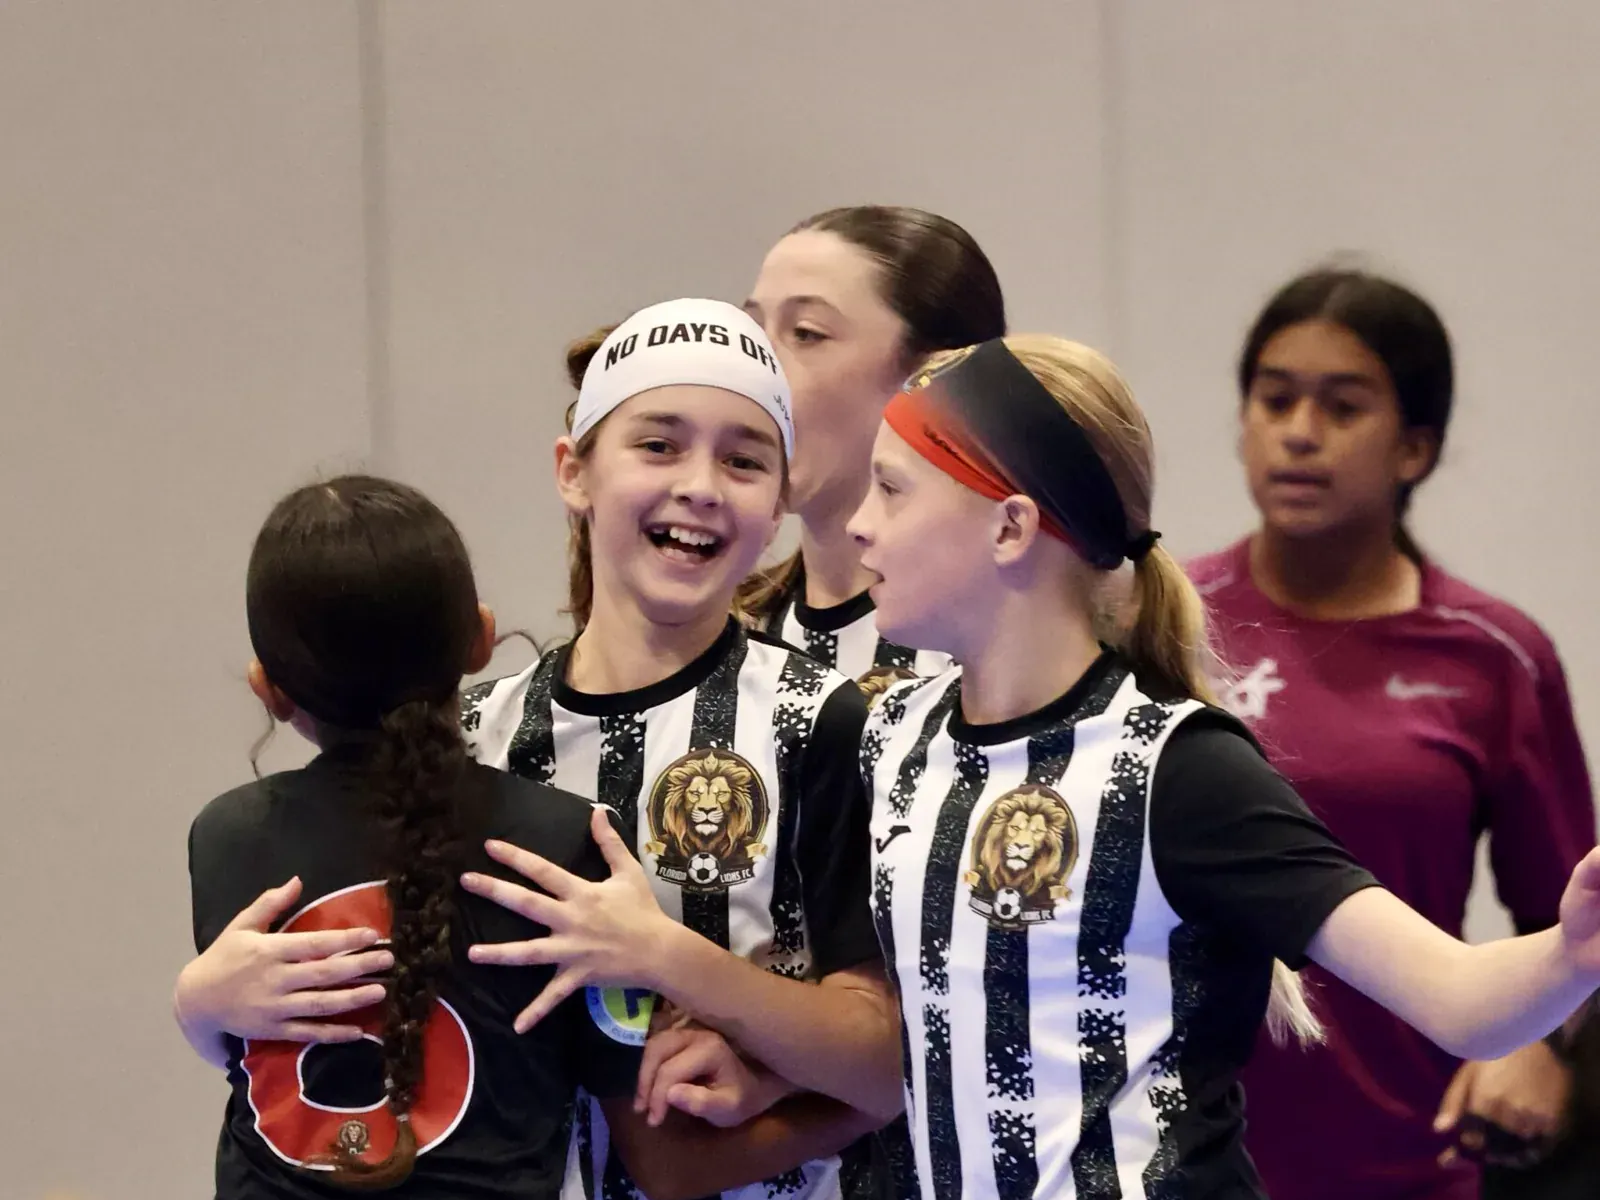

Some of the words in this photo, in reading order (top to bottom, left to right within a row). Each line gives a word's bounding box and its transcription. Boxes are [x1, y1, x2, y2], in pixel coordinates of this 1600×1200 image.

[604, 333, 639, 371] NO
[647, 323, 729, 347] DAYS
[720, 870, 741, 883] LIONS
[742, 868, 752, 879] FC
